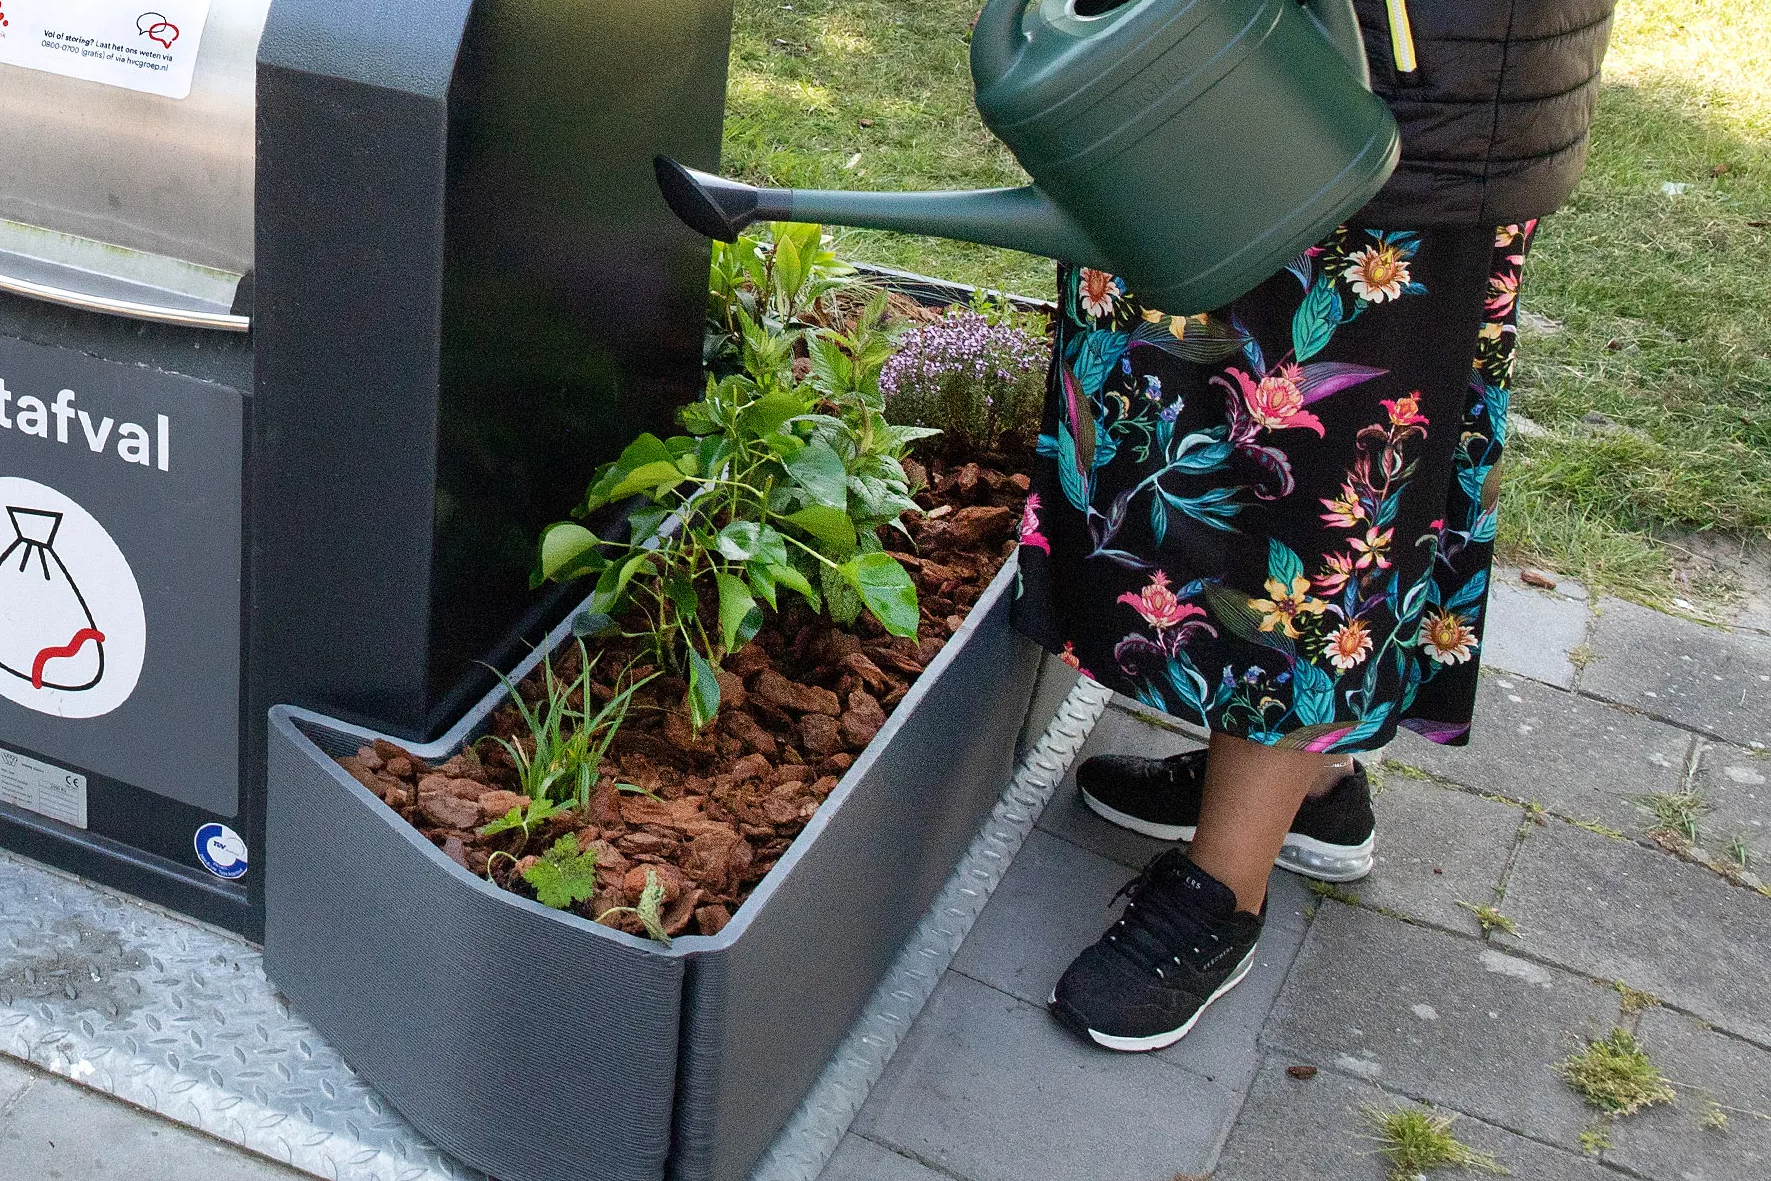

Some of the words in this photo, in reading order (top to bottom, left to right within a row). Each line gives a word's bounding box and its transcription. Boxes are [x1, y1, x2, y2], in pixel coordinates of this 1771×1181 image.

[41, 40, 79, 53] 0800-0700
[81, 47, 106, 60] (gratis)
[106, 52, 114, 61] of
[115, 54, 126, 63] via
[126, 56, 169, 72] hvcgroep.nl
[44, 29, 55, 38] Vol
[56, 32, 64, 40] of
[65, 34, 95, 49] storing?
[96, 40, 110, 50] Laat
[111, 43, 123, 52] het
[125, 47, 138, 55] ons
[139, 50, 161, 59] weten
[162, 53, 173, 62] via
